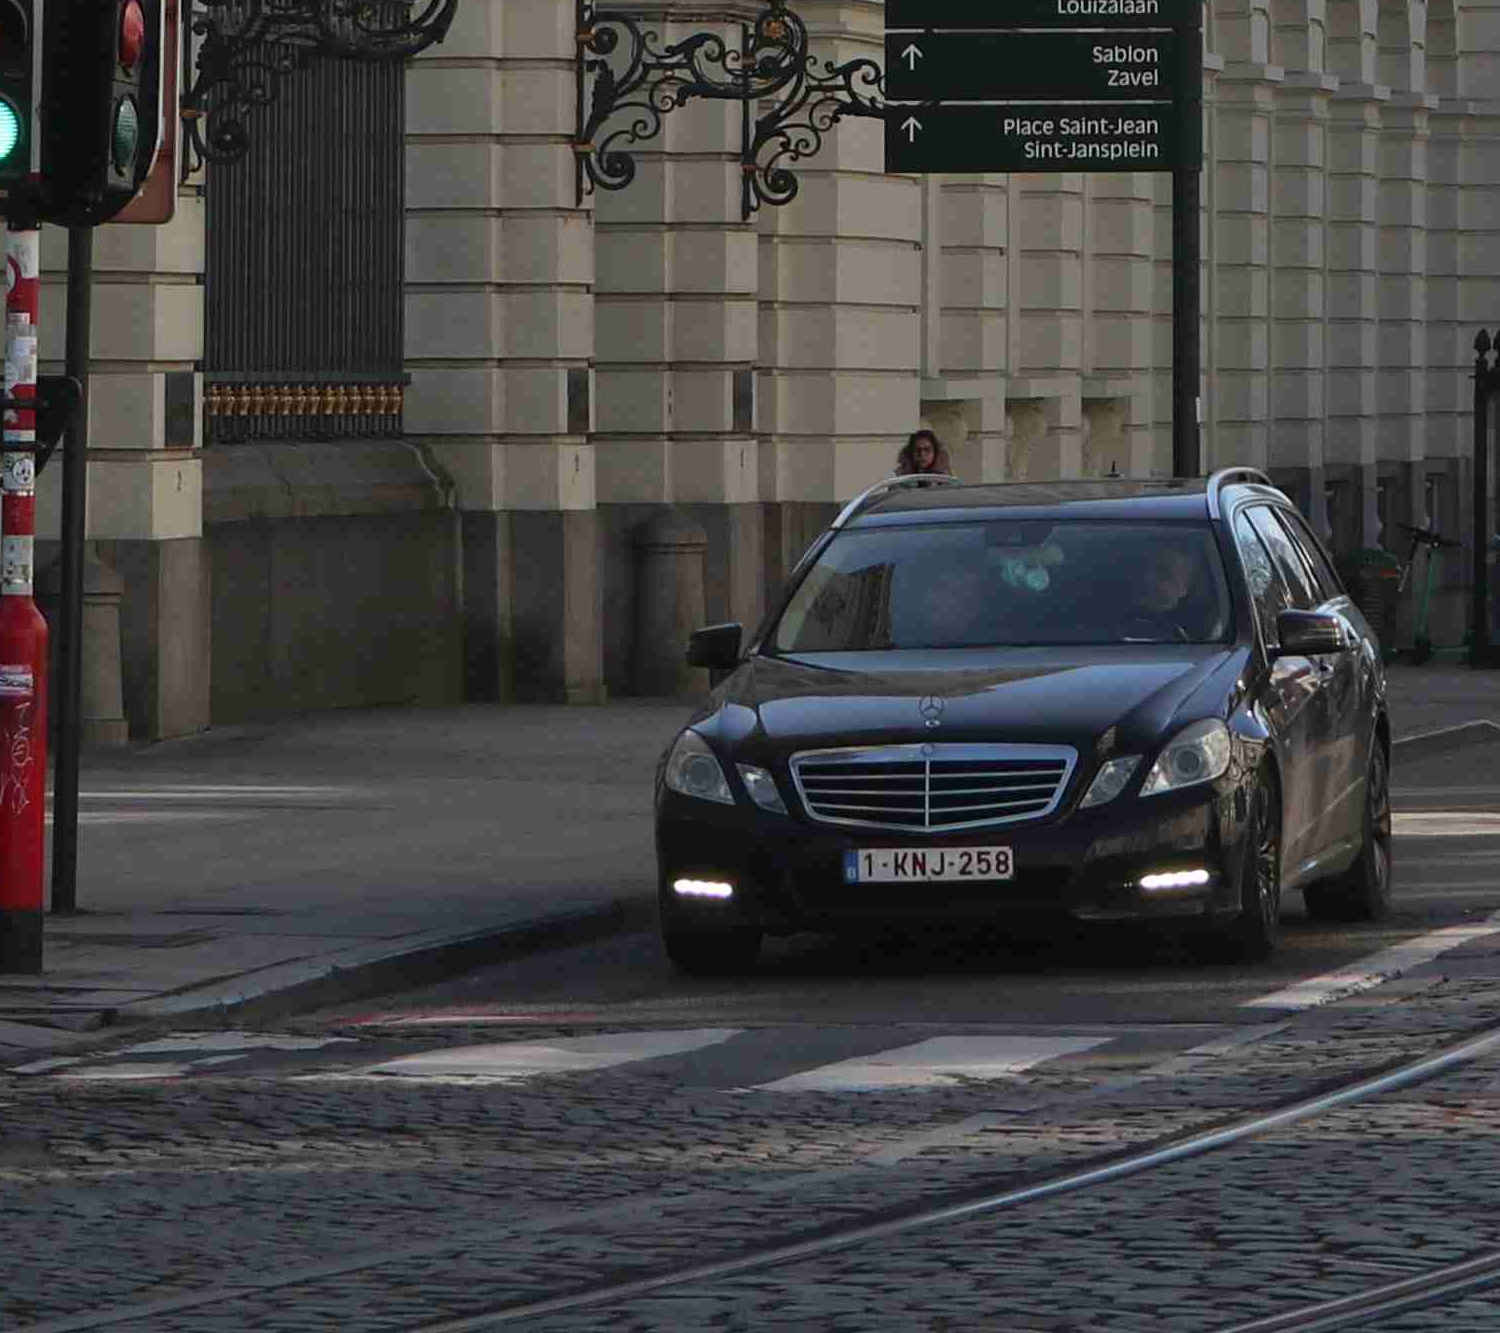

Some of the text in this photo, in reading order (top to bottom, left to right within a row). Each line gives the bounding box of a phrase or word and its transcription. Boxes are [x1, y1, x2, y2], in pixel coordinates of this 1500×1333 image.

[1092, 45, 1159, 63] Sablon
[1107, 69, 1159, 86] Zavel
[1003, 117, 1159, 136] Place Saint-Jean
[1024, 141, 1159, 161] Sint-Jansplein
[864, 851, 1010, 877] 1-KNJ-258
